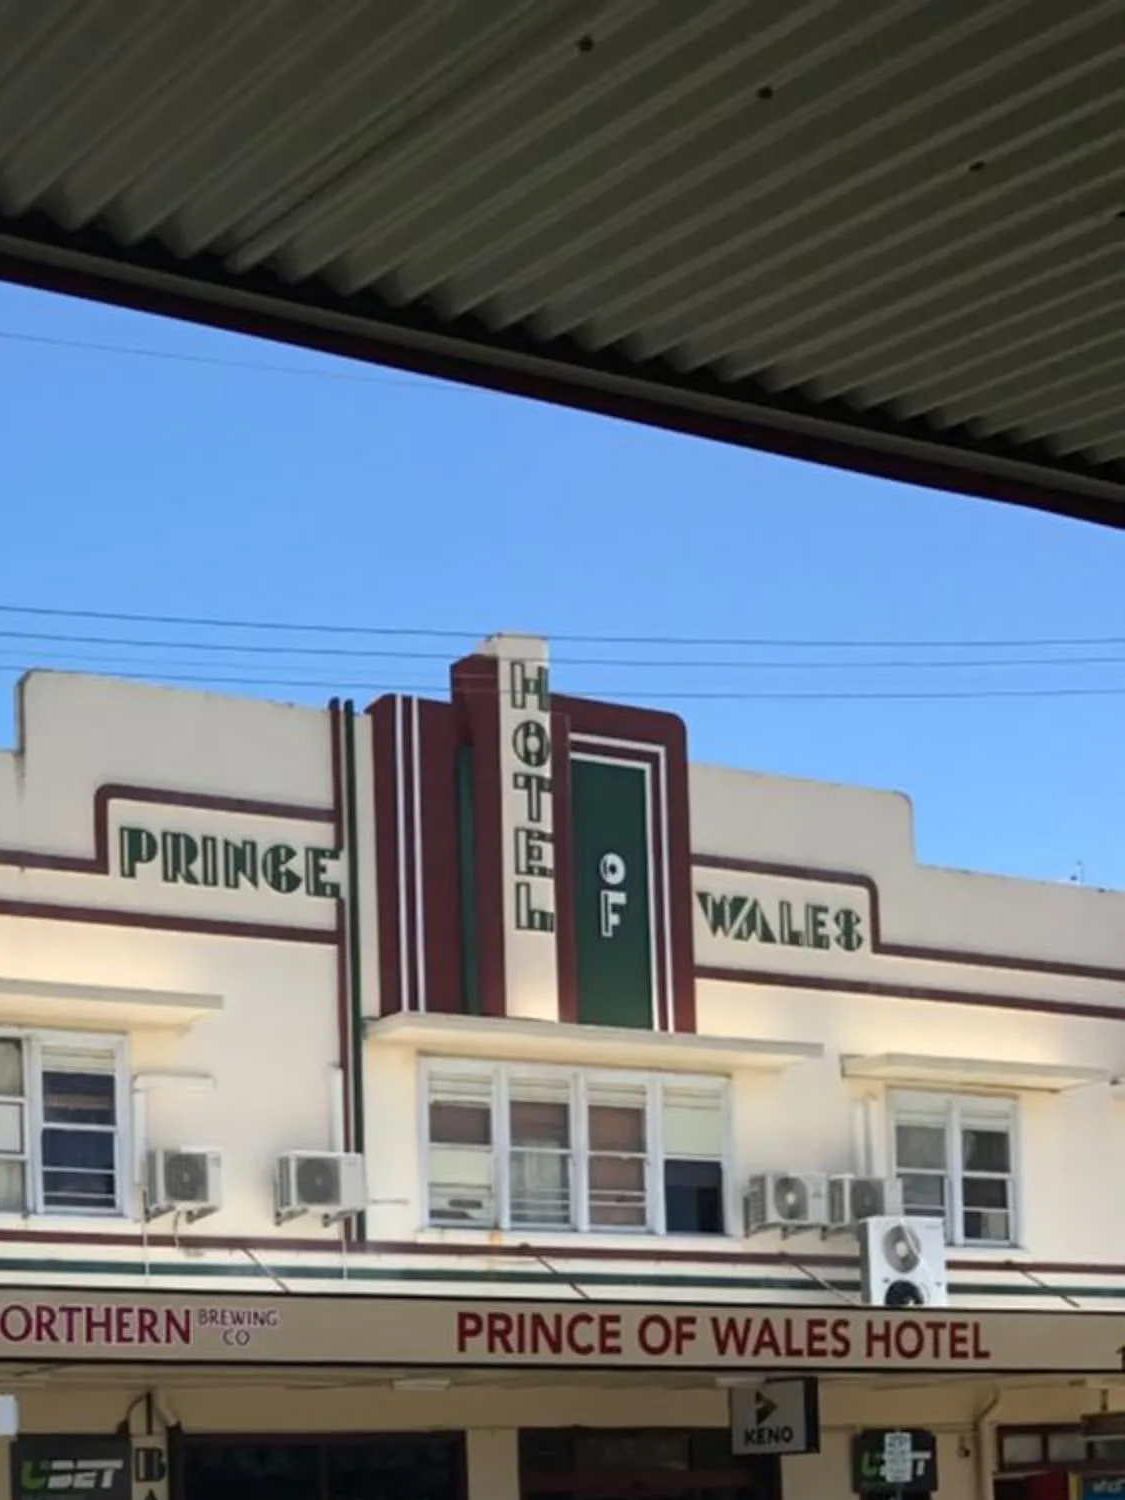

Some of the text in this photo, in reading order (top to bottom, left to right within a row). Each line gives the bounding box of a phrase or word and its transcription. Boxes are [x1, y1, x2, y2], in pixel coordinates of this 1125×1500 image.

[510, 661, 554, 932] HOTEL
[119, 826, 340, 898] PRINCE
[600, 853, 627, 937] OF
[696, 892, 864, 952] WALES
[198, 1308, 278, 1327] BREWING
[222, 1329, 250, 1346] CO
[457, 1312, 991, 1359] PRINCE OF WALES HOTEL
[743, 1425, 794, 1447] KENO
